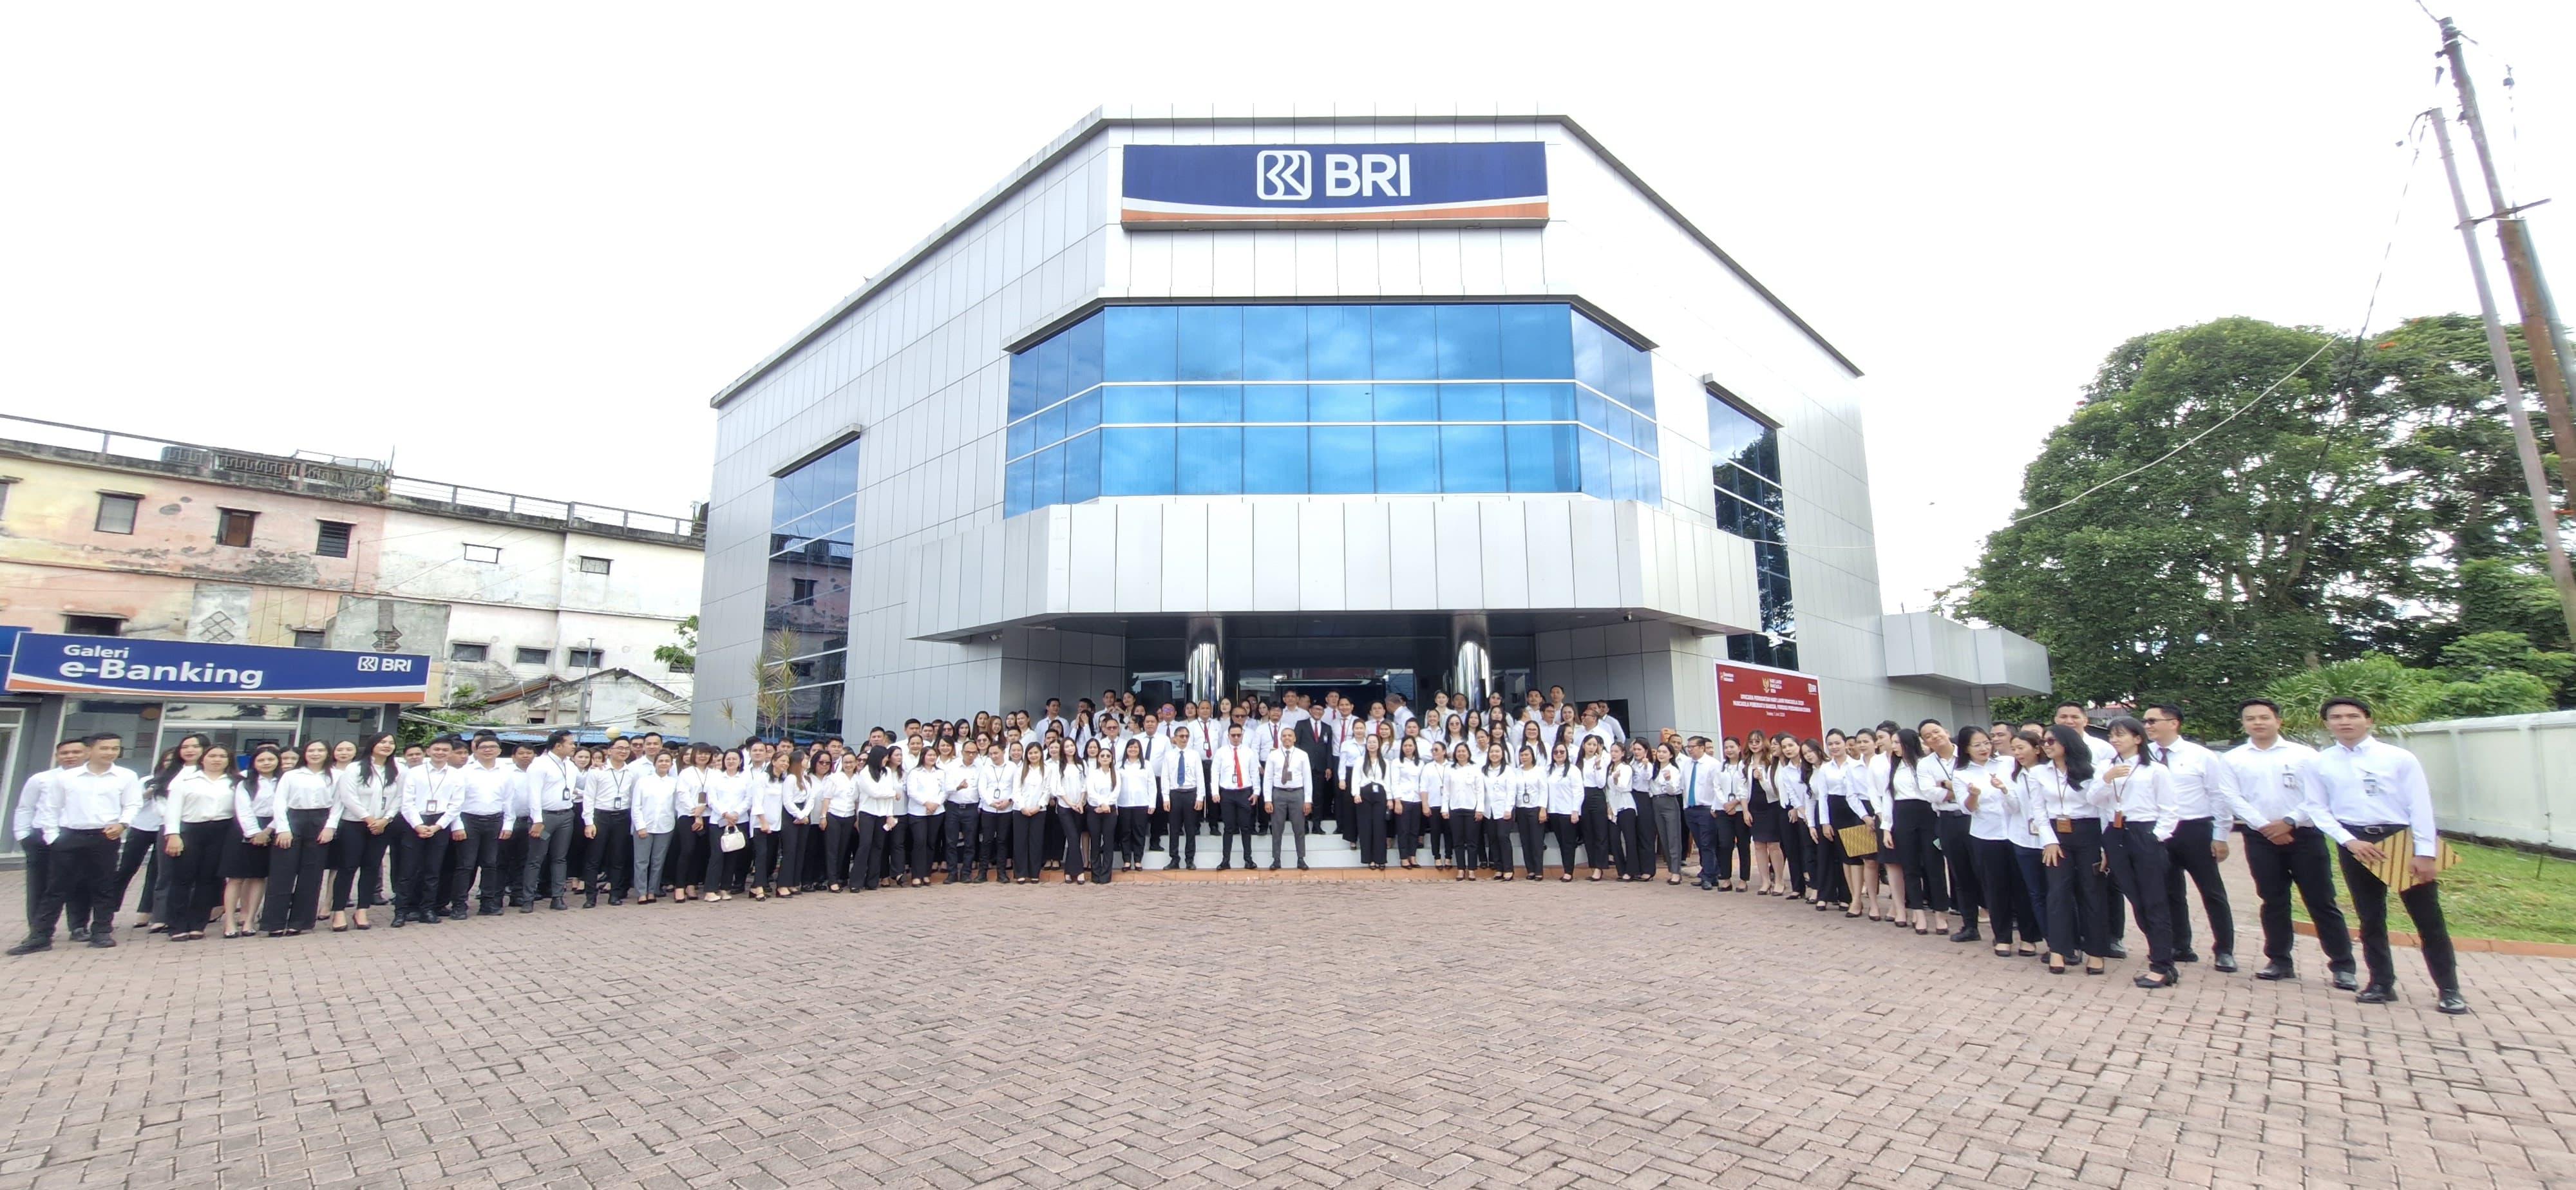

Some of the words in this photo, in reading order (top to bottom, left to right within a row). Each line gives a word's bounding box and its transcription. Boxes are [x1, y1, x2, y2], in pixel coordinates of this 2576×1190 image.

[1325, 154, 1411, 196] BRI
[63, 645, 129, 659] Galeri
[59, 659, 263, 689] e-Banking
[381, 658, 412, 672] BRI
